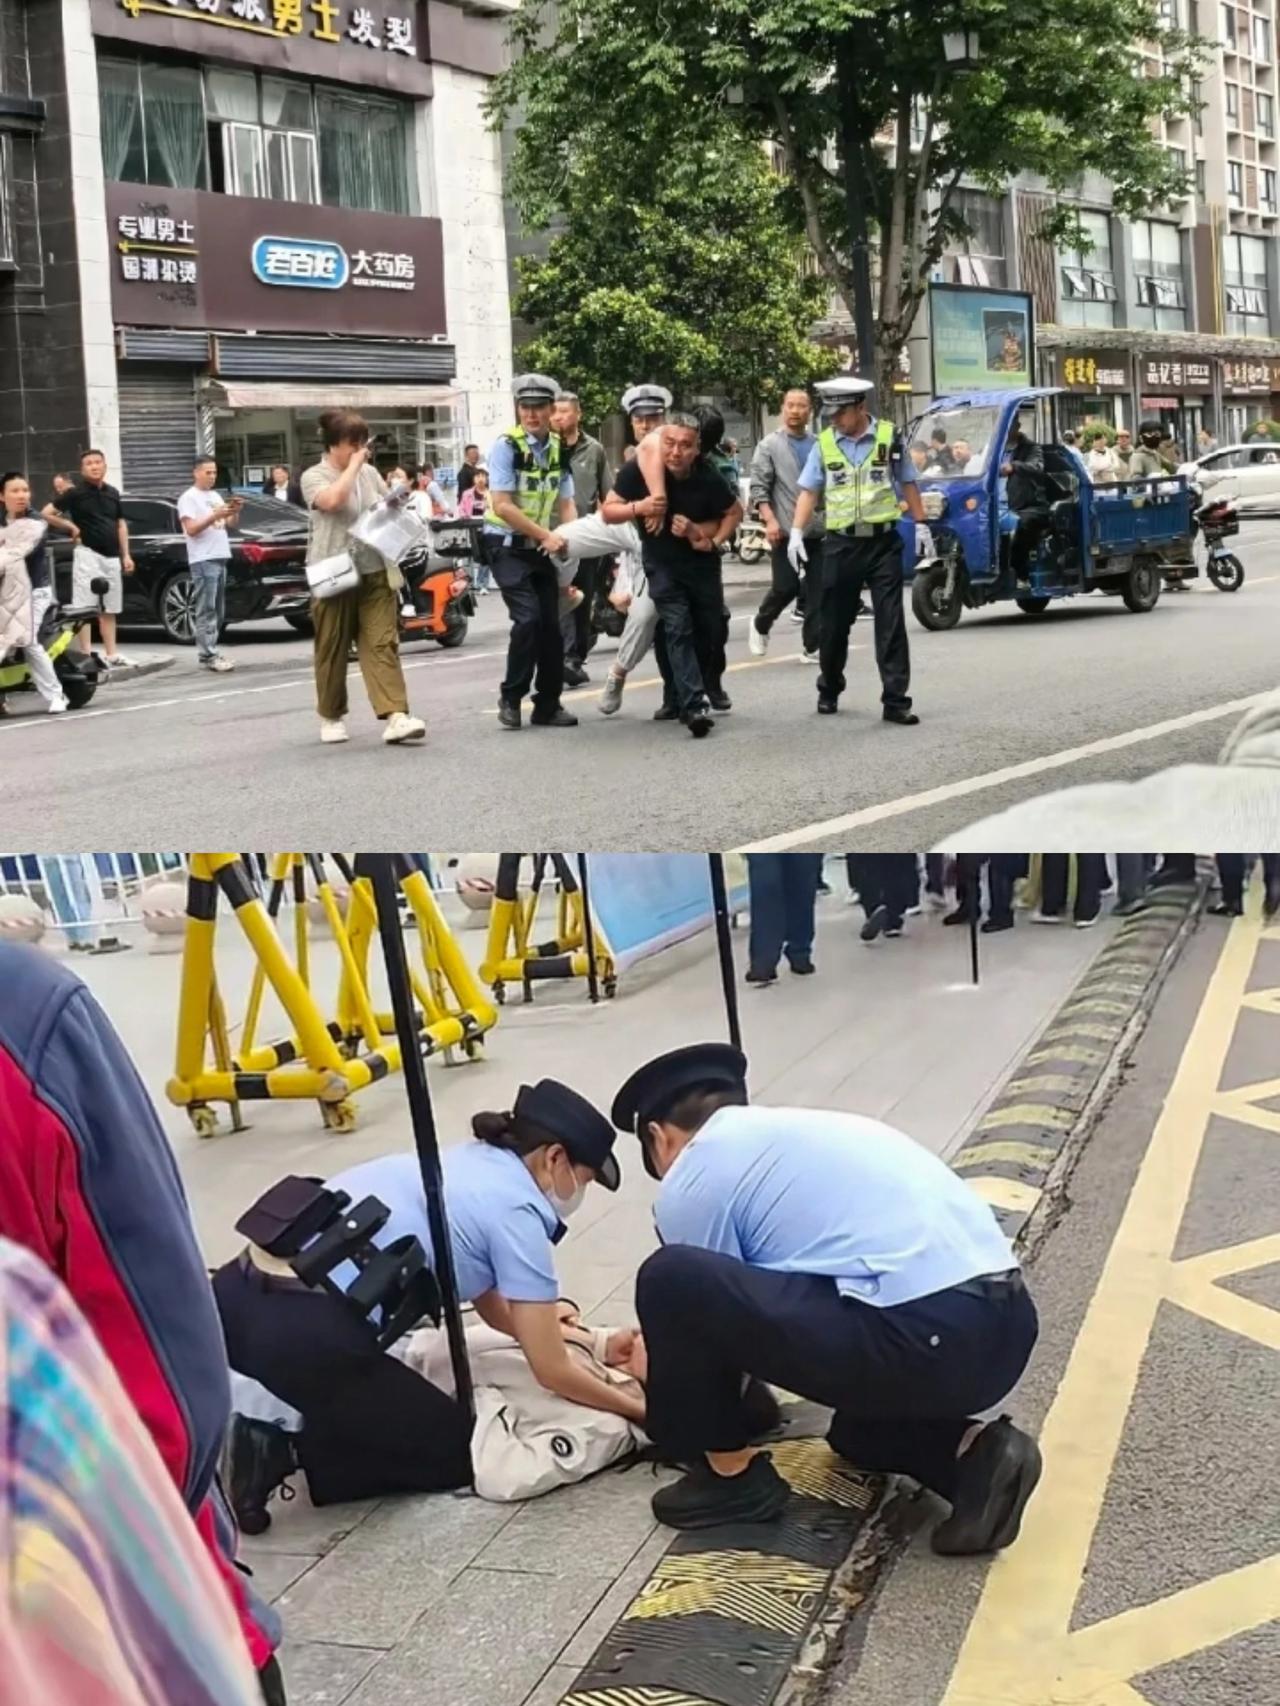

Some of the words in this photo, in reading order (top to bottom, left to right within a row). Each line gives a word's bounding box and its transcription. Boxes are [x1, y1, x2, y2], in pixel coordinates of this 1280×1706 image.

[118, 216, 195, 244] 专业男士
[351, 250, 416, 279] 大药房
